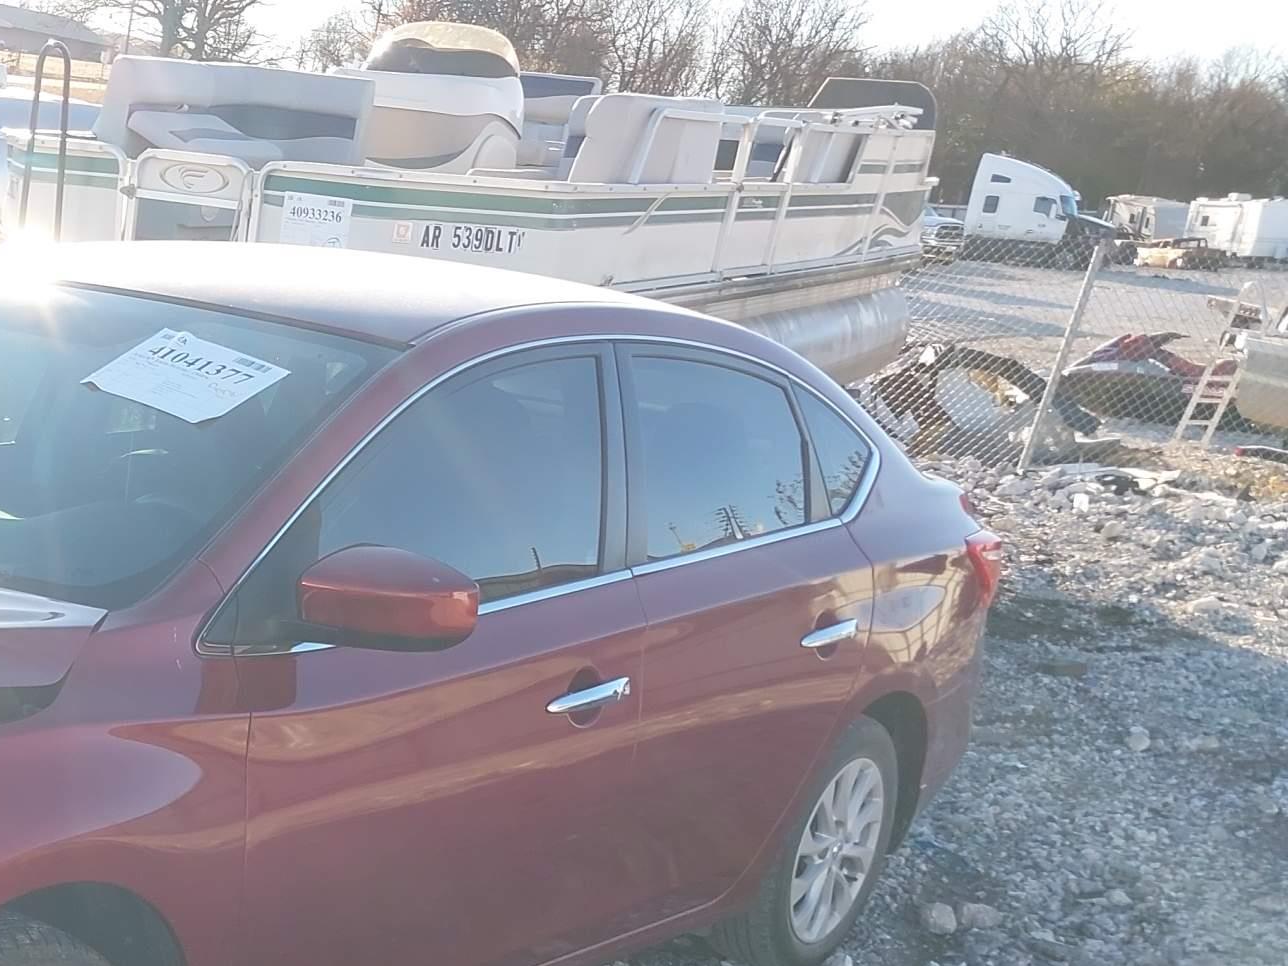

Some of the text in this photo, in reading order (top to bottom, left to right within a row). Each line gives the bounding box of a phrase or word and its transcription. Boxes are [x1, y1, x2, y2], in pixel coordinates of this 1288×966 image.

[289, 206, 342, 224] 40933236
[420, 225, 443, 249] AR
[148, 346, 255, 385] 41041377
